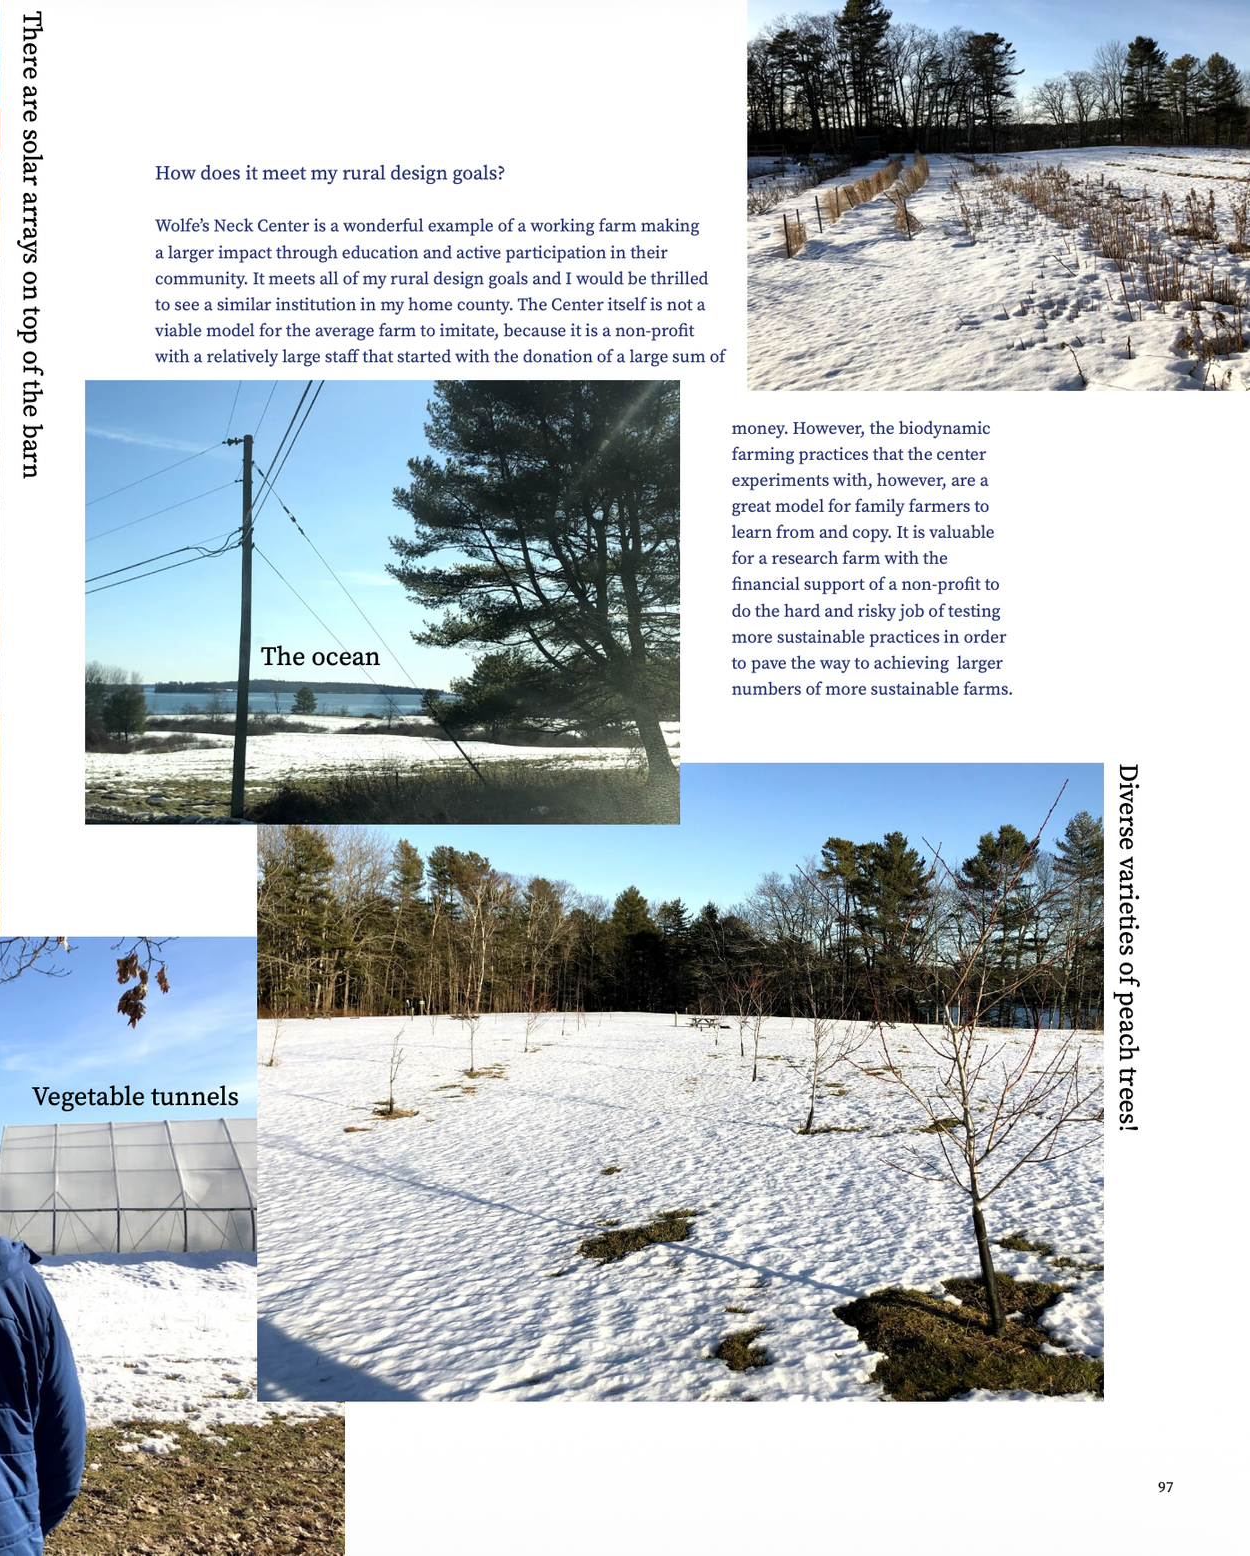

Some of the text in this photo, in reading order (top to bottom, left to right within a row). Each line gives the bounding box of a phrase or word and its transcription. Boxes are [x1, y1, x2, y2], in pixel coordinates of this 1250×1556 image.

[155, 164, 505, 185] How does it meet my rural design goals?
[154, 217, 700, 237] Wolfe’s Neck Center is a wonderful example of a working farm making
[16, 10, 45, 480] There are solar arrays on top of the barn
[155, 270, 709, 290] community. It meets all of my rural design goals and I would be thrilled
[731, 420, 991, 439] money. However, the biodynamic
[731, 472, 989, 491] experiments with, however, are a
[731, 576, 1000, 595] financial support of a non-profit to
[731, 680, 1013, 696] numbers of more sustainable farms.
[1113, 763, 1141, 1131] Diverse varieties of peach trees!
[1158, 1481, 1174, 1493] 97
